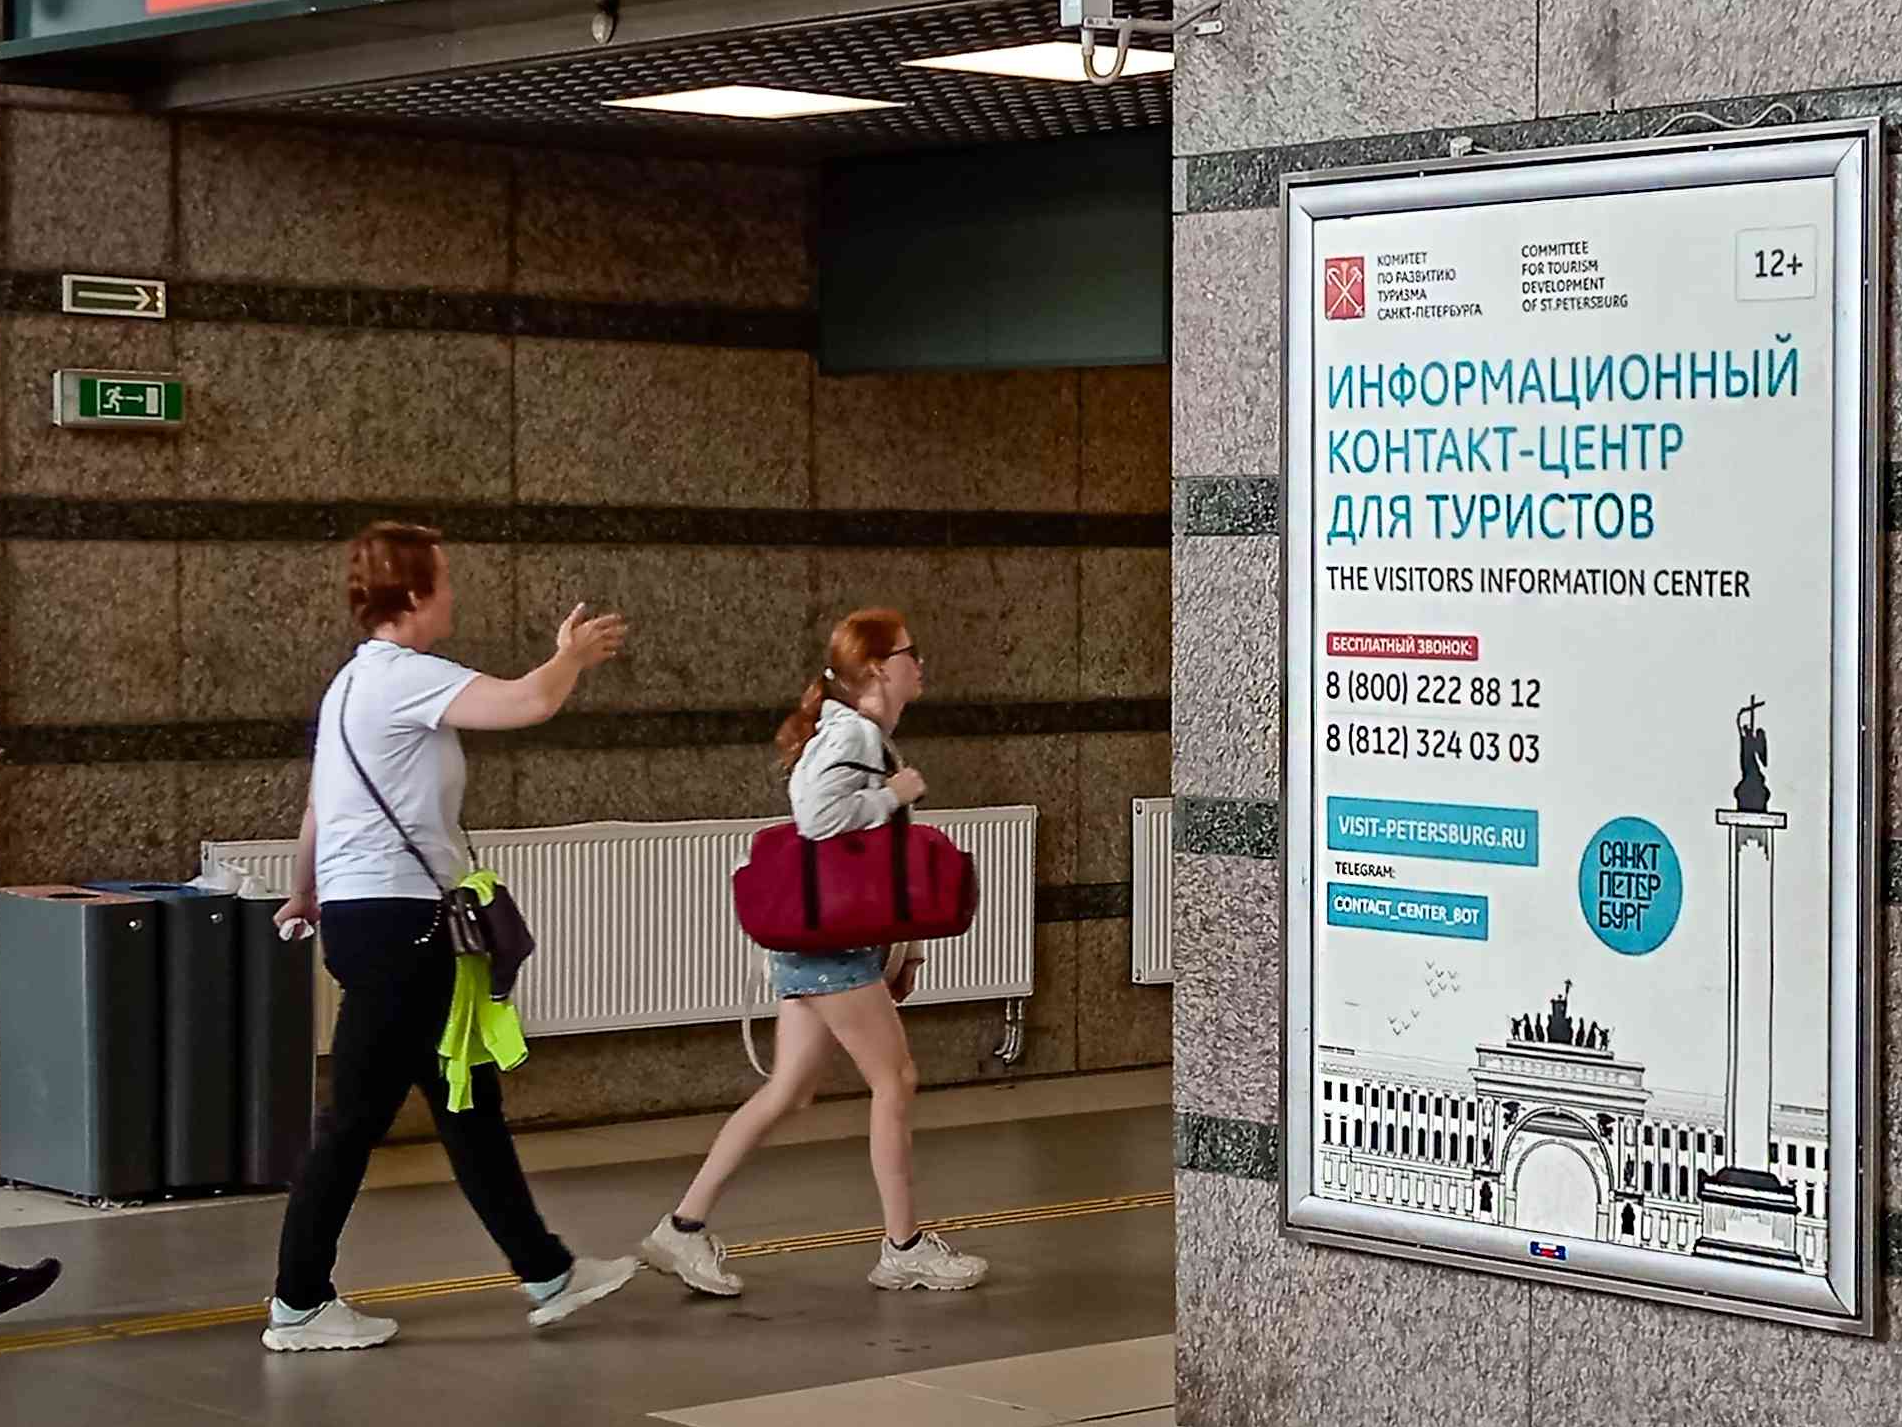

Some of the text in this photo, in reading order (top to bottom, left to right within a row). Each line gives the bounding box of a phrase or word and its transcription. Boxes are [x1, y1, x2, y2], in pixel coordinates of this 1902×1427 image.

[1377, 252, 1428, 267] КОМИТЕТ
[1521, 241, 1590, 258] COMMITTEE
[1377, 269, 1457, 285] ПО РАЗВИТИЮ
[1521, 259, 1599, 277] FOR TOURISM
[1754, 249, 1804, 279] 12+
[1377, 288, 1428, 303] ТУРИЗМА
[1521, 277, 1606, 294] DEVELOPMENT
[1377, 303, 1483, 321] САНКТ-ПЕТЕРБУРГА
[1521, 299, 1538, 313] OF
[1327, 333, 1800, 410] ИНФОРМАЦИОННЫЙ
[1327, 422, 1684, 479] КОНТАКТ-ЦЕНТР
[1327, 491, 1655, 546] ДЛЯ ТУРИСТОВ
[1327, 566, 1750, 598] THE VISITORS INFORMATION CENTER
[1332, 634, 1474, 657] БЕСПЛАТНЫЙ ЗВОНОК:
[1326, 671, 1541, 708] 8 (800) 222 88 12
[1326, 724, 1540, 763] 8 (812) 324 03 03
[1338, 814, 1527, 850] VISIT-PETERSBURG.RU
[1599, 841, 1661, 870] САНКТ
[1335, 861, 1396, 879] TELEGRAM:
[1599, 873, 1661, 901] ПЕТЕР
[1334, 895, 1481, 925] CONTACT_CENTER_BOT
[1599, 902, 1651, 931] БУРГ
